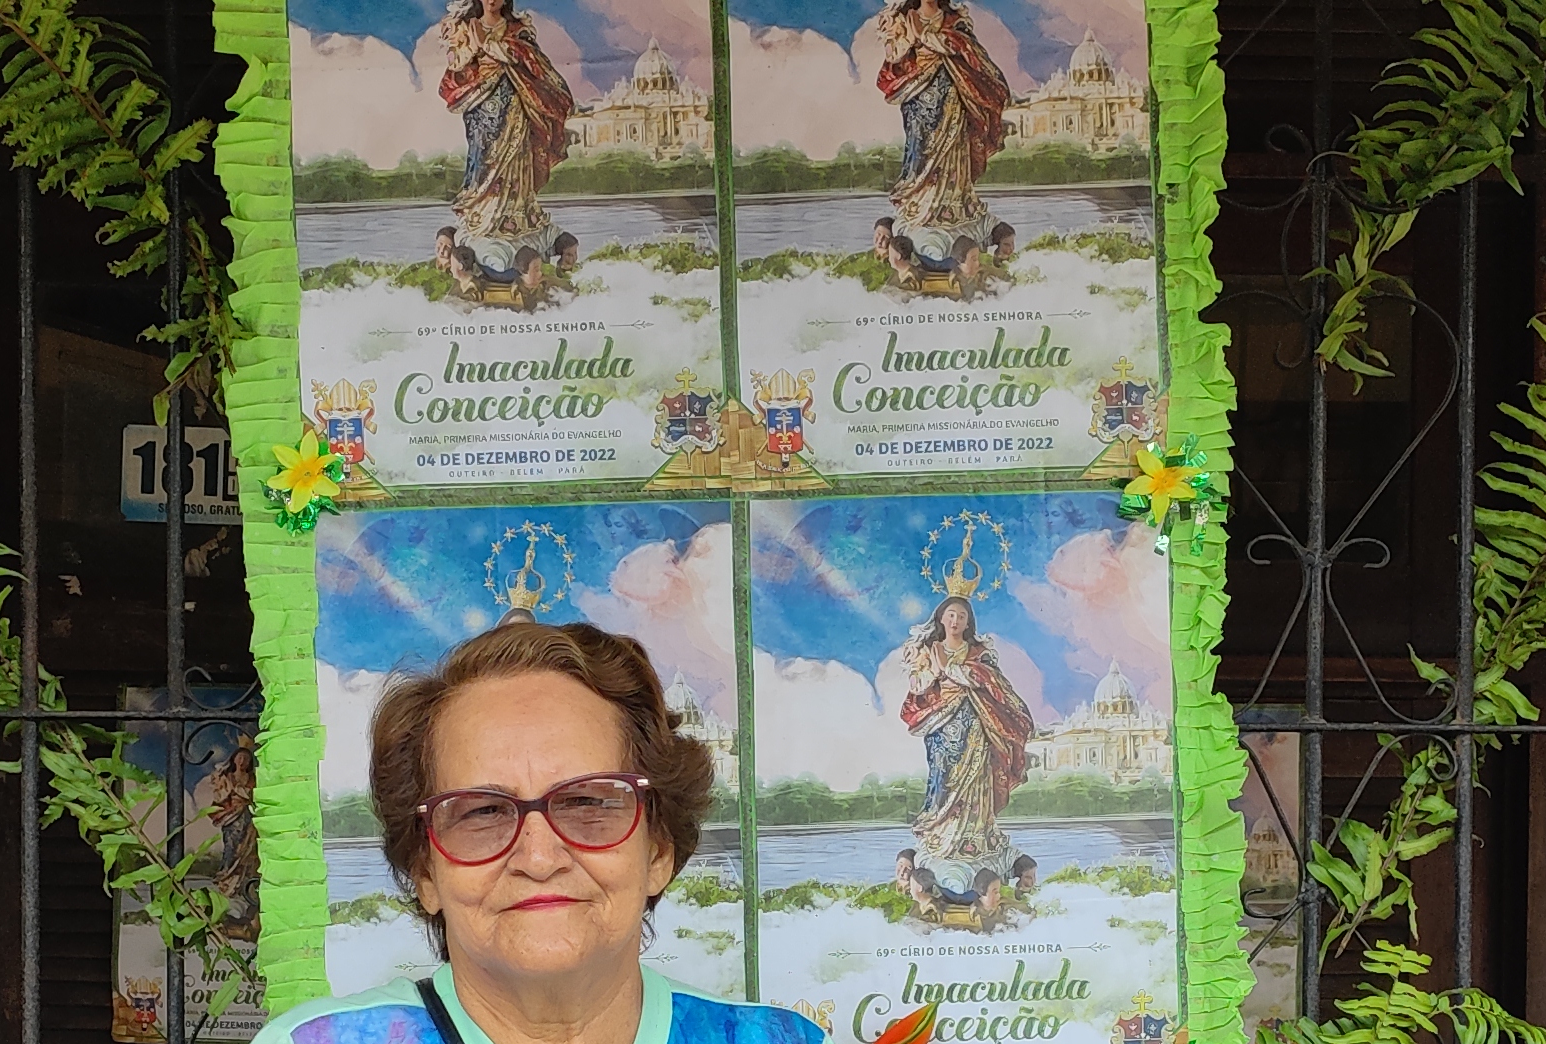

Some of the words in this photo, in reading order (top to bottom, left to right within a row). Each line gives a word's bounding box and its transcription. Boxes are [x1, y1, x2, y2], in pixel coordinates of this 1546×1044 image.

[855, 317, 875, 327] 69º
[879, 313, 914, 326] CÍRIO
[918, 314, 934, 324] DE
[938, 313, 979, 323] NOSSA
[983, 311, 1043, 322] SENHORA
[441, 323, 476, 336] CÍRIO
[480, 325, 496, 335] DE
[500, 323, 542, 335] NOSSA
[545, 321, 606, 333] SENHORA
[881, 325, 1073, 373] Imaculada
[443, 335, 635, 384] Imaculada
[832, 362, 1051, 416] Conceição
[393, 373, 613, 427] Conceição
[990, 420, 1003, 429] DO
[1005, 418, 1059, 429] EVANGELHO
[489, 430, 550, 442] MISSIONÁRIA
[552, 431, 565, 440] DO
[567, 429, 622, 440] EVANGELHO
[855, 443, 874, 456] 04
[878, 441, 899, 455] DE
[903, 439, 989, 454] DEZEMBRO
[993, 437, 1014, 451] DE
[1017, 437, 1054, 451] 2022
[416, 454, 436, 467] 04
[440, 453, 461, 466] DE
[464, 450, 551, 466] DEZEMBRO
[555, 448, 576, 463] DE
[579, 448, 617, 462] 2022
[887, 458, 934, 468] OUTEIRO
[448, 469, 495, 478] OUTEIRO
[900, 945, 934, 957] CÍRIO
[938, 946, 954, 957] DE
[959, 945, 1001, 956] NOSSA
[1004, 943, 1063, 955] SENHORA
[901, 957, 1092, 1004] Imaculada
